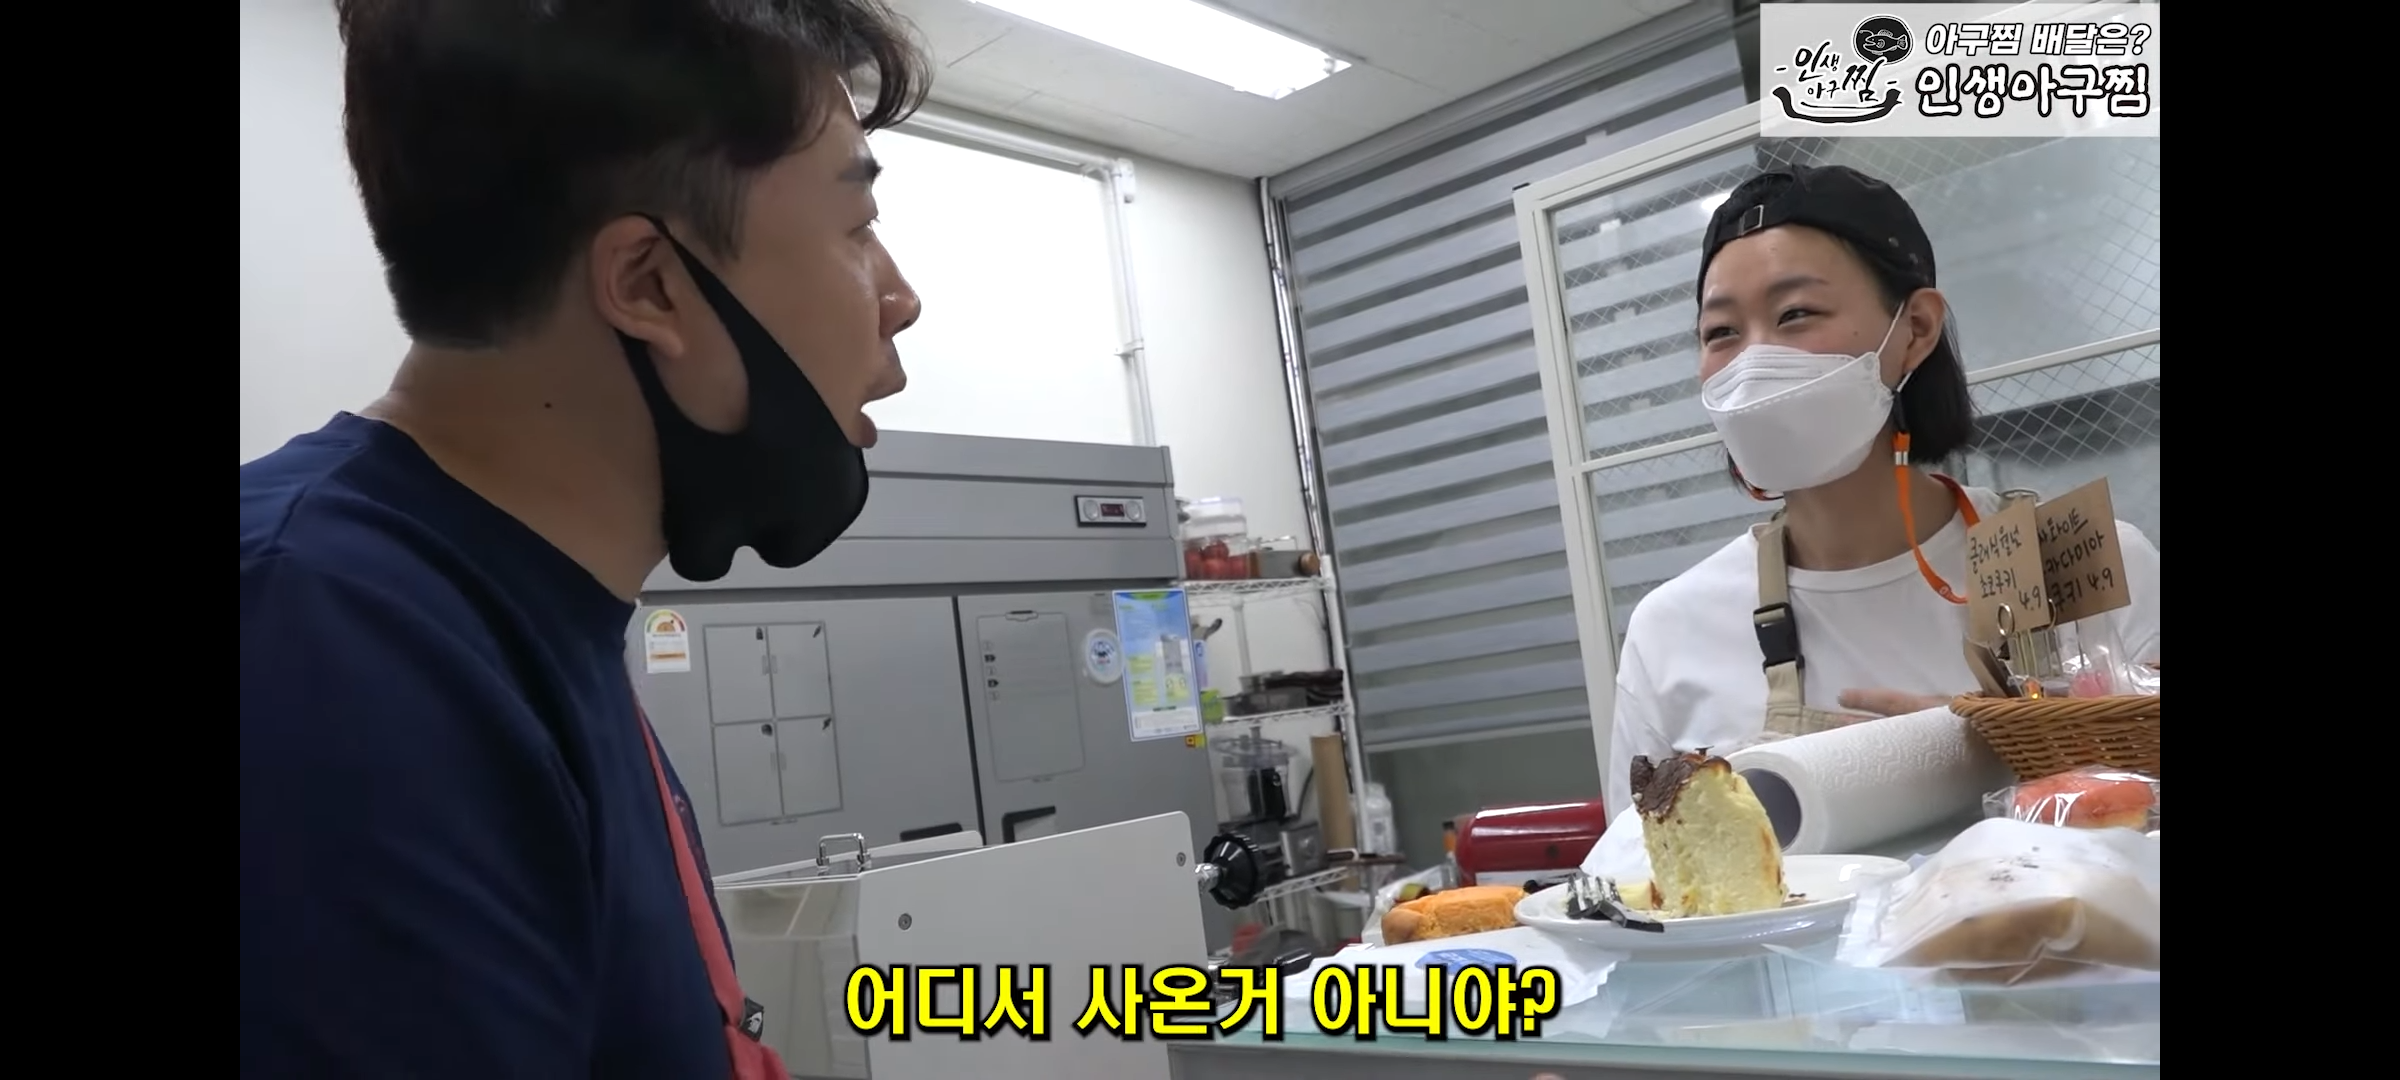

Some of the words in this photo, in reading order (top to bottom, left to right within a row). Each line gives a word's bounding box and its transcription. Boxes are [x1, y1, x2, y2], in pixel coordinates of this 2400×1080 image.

[2038, 508, 2089, 543] 화이트
[2042, 529, 2105, 576] 카다미아
[2086, 566, 2114, 591] 4.9
[2018, 585, 2042, 611] 4.9
